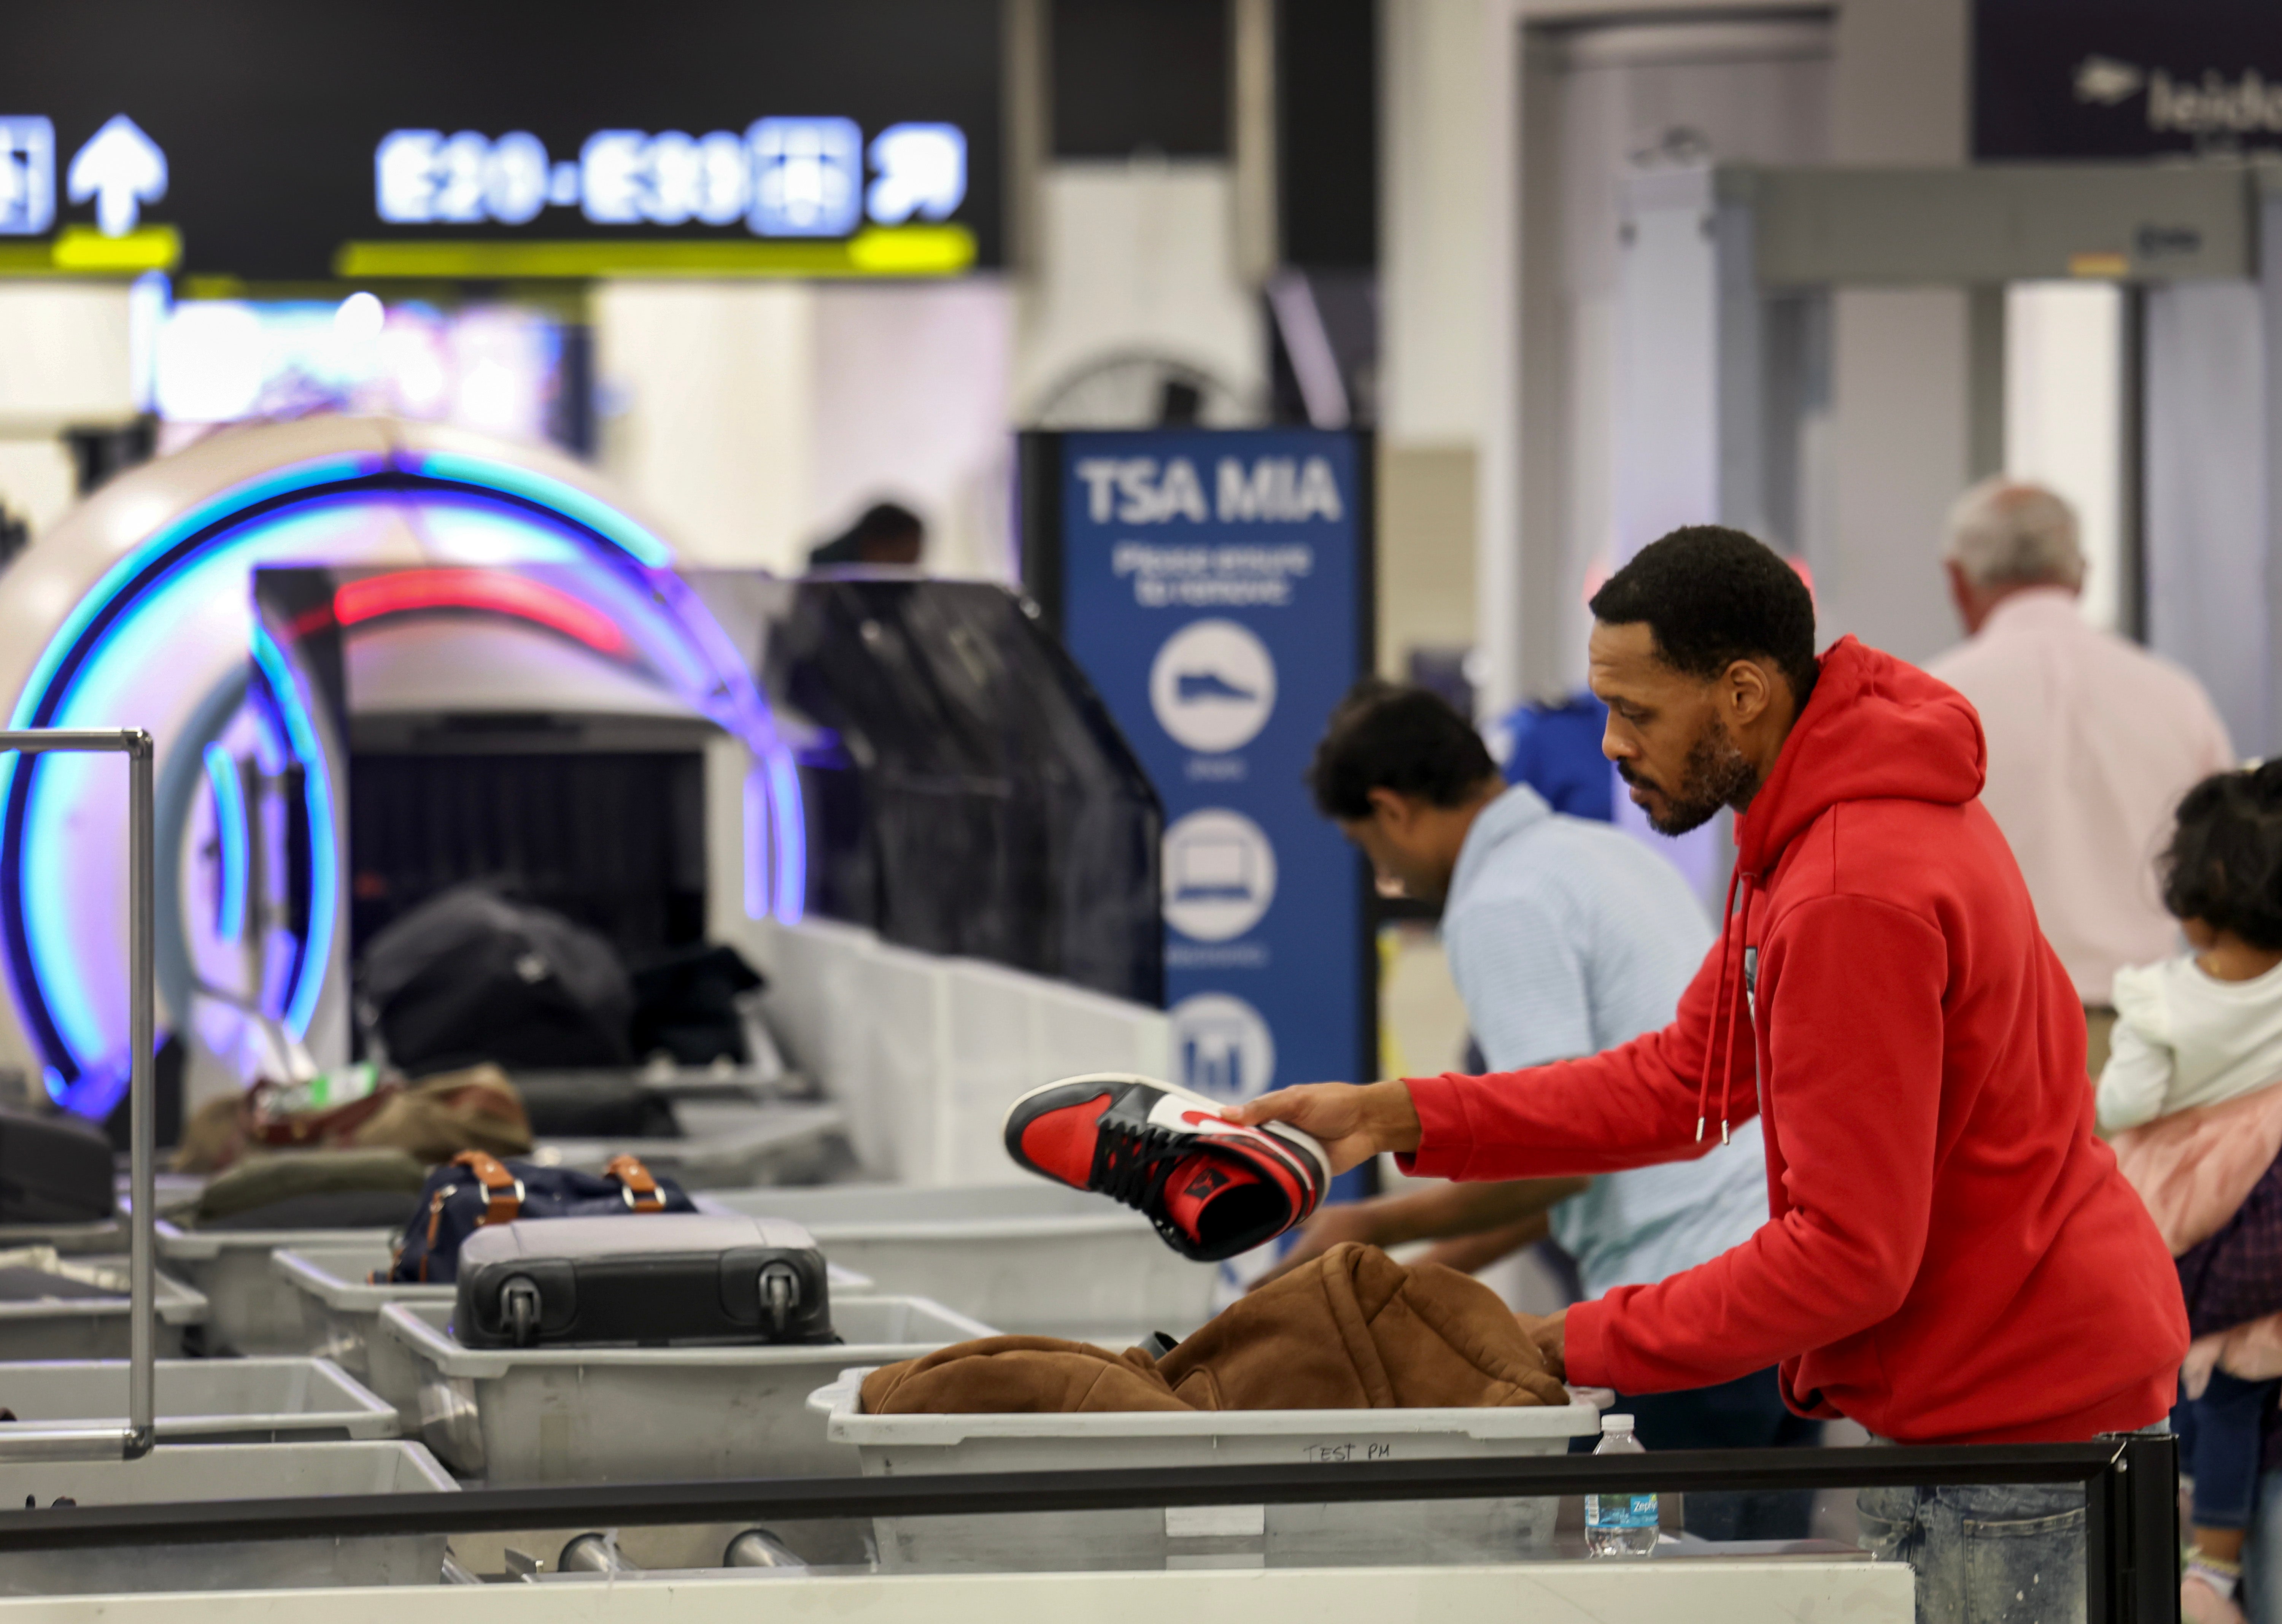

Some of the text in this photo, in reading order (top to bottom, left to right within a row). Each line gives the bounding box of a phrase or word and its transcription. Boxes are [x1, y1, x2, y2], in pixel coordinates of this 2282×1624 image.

[1077, 459, 1342, 523] TSA MIA
[1303, 1443, 1356, 1462] TEST
